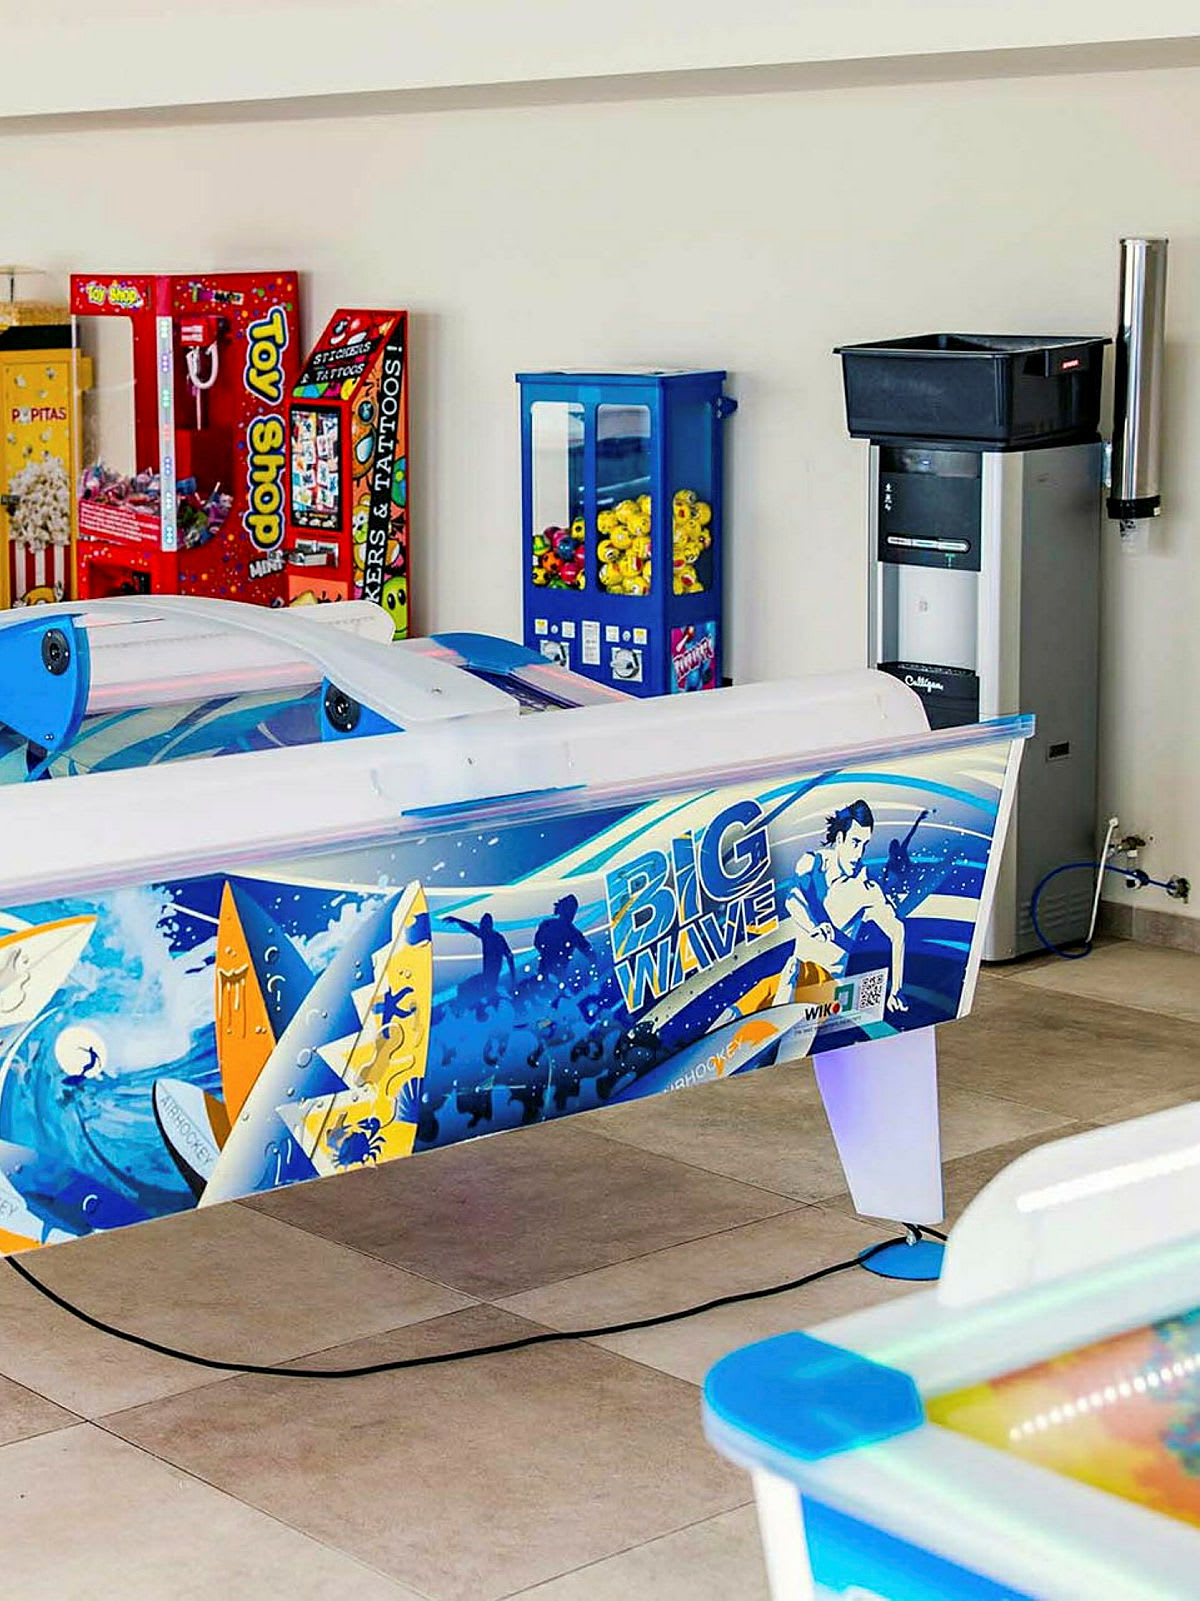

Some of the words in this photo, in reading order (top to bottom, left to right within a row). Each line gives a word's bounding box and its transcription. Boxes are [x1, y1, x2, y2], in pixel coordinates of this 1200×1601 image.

[246, 308, 289, 403] Toy
[313, 341, 372, 365] STICKERS
[316, 363, 366, 382] TATTOOS
[11, 406, 67, 422] PPITAS
[245, 416, 286, 549] Shop
[373, 502, 389, 518] &
[606, 799, 771, 963] BIG
[614, 879, 779, 1014] WAVE
[663, 1034, 743, 1092] IRHOCKEY
[160, 1095, 213, 1166] AIRHOCKEY
